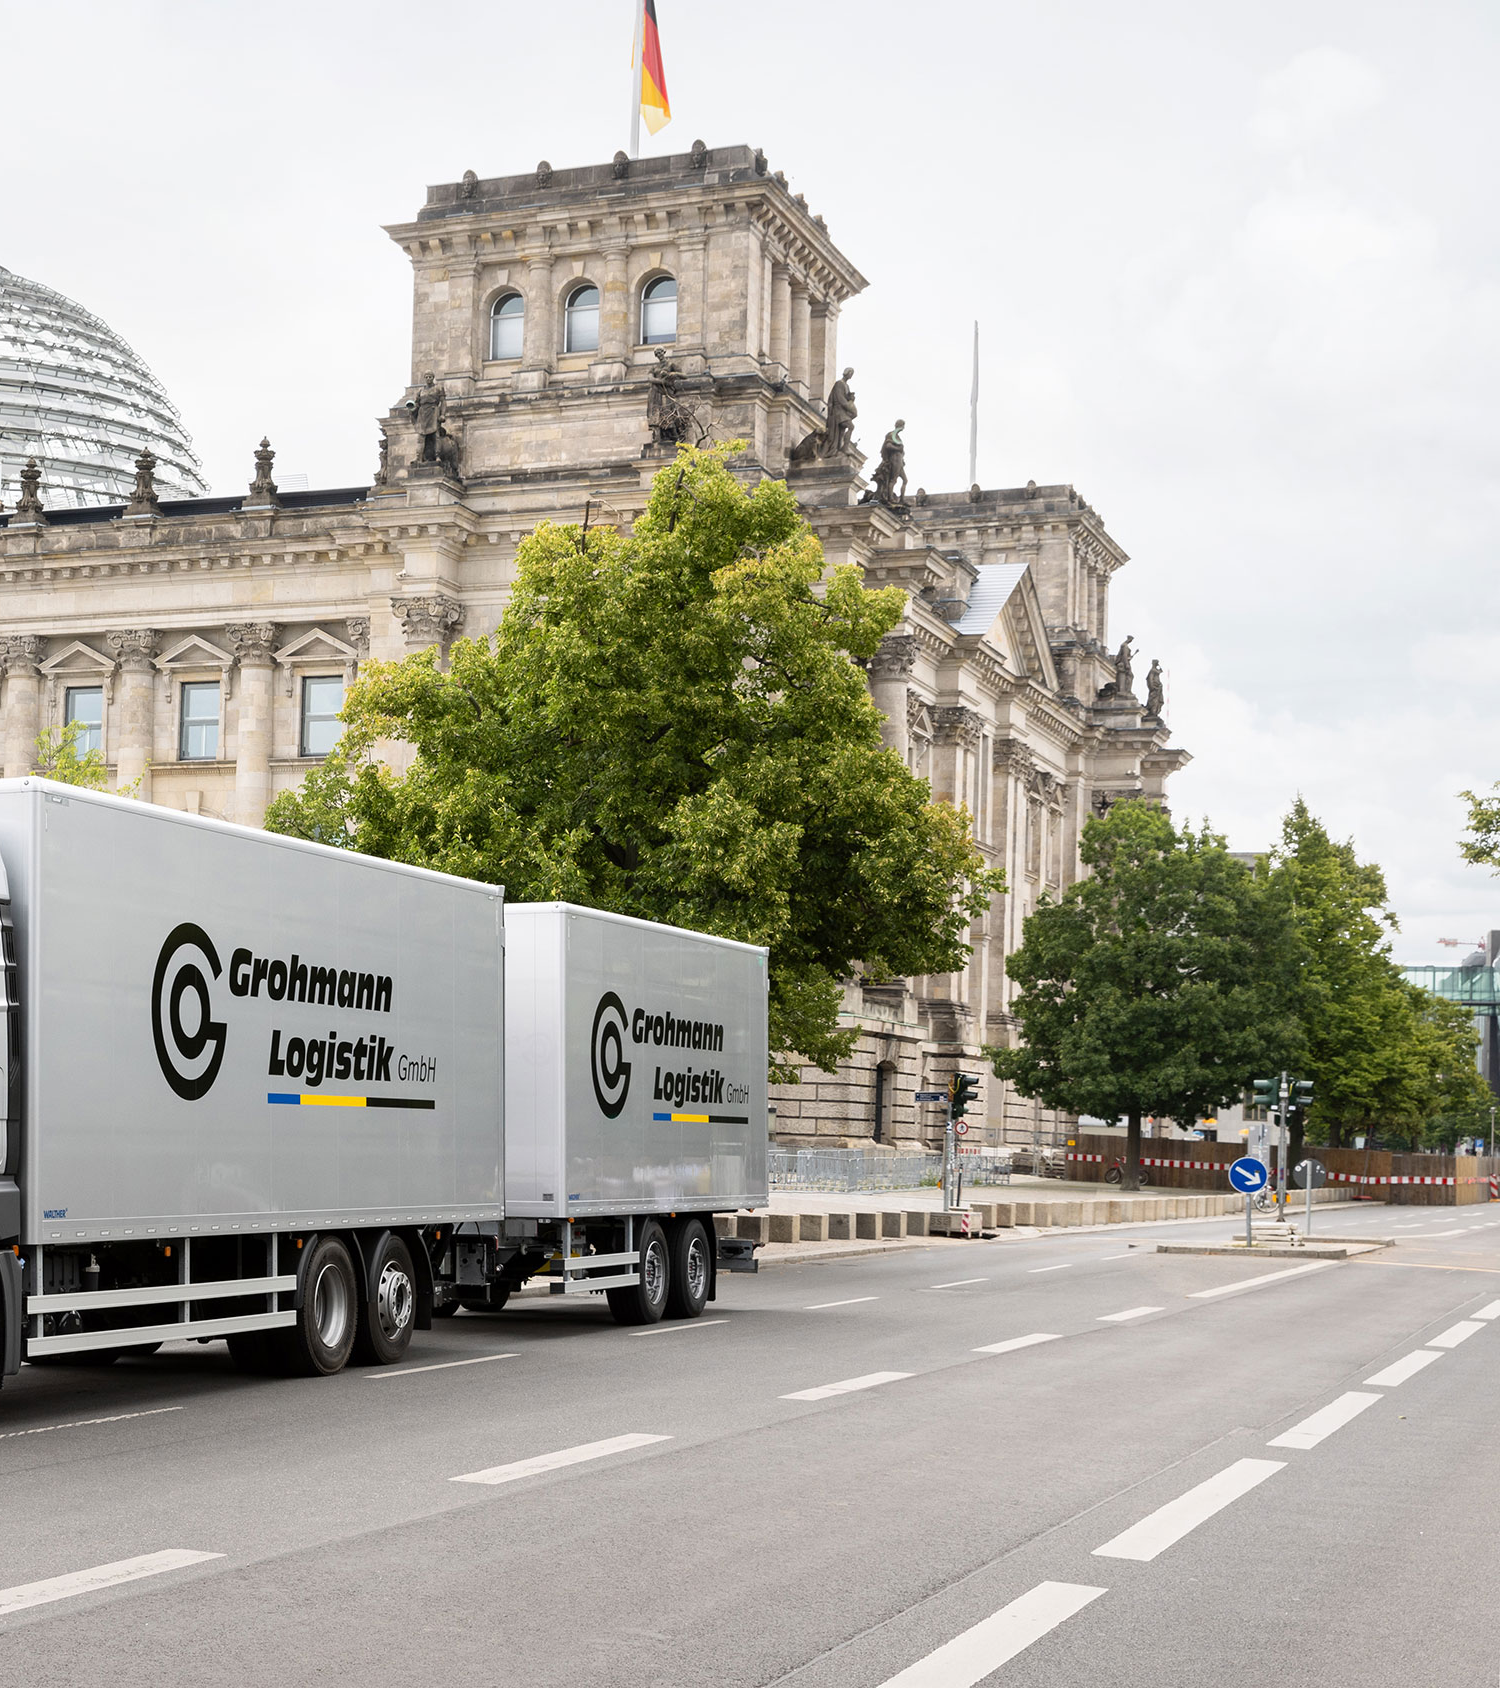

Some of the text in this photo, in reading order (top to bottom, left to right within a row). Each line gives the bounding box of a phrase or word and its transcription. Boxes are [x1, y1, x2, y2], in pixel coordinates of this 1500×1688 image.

[229, 947, 393, 1013] Grohmann
[631, 1007, 724, 1052] Grohmann
[268, 1029, 437, 1087] Logistik GmbH
[653, 1066, 749, 1108] Logistik GmbH
